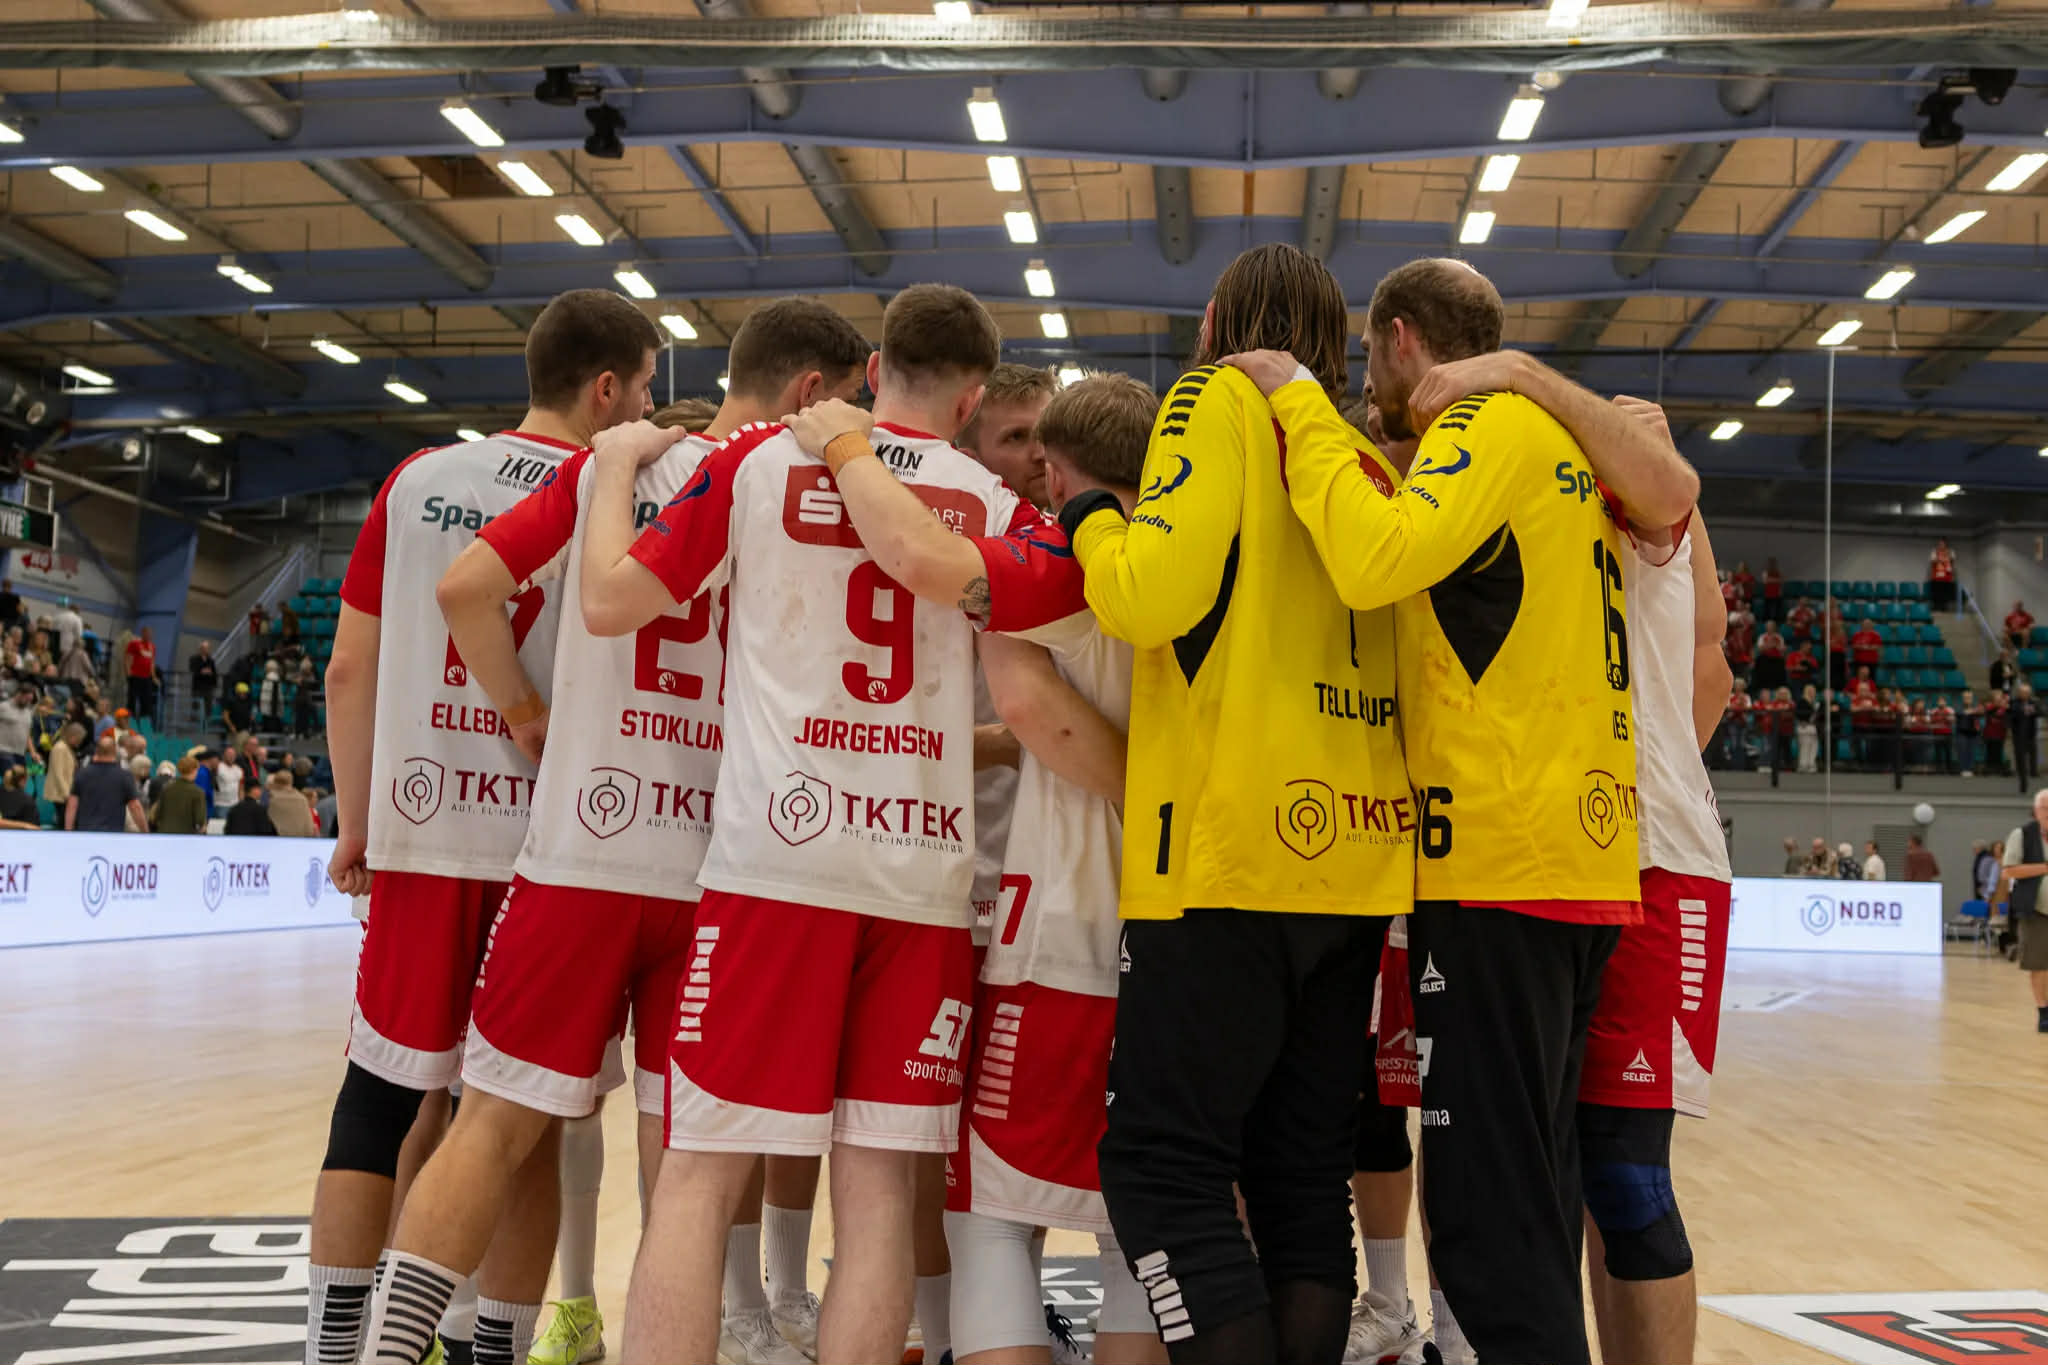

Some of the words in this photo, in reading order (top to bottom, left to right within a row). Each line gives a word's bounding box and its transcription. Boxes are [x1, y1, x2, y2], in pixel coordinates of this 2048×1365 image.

[841, 560, 915, 704] 9
[794, 716, 944, 761] JØRGENSEN
[841, 790, 964, 842] TKTEK
[1156, 801, 1174, 875] 1
[112, 863, 158, 891] NORD
[228, 863, 270, 888] TKTEK
[999, 874, 1032, 945] 7
[1840, 901, 1903, 921] NORD
[1419, 980, 1446, 994] SELECT
[903, 1059, 947, 1083] sports
[1622, 1071, 1656, 1083] SELECT
